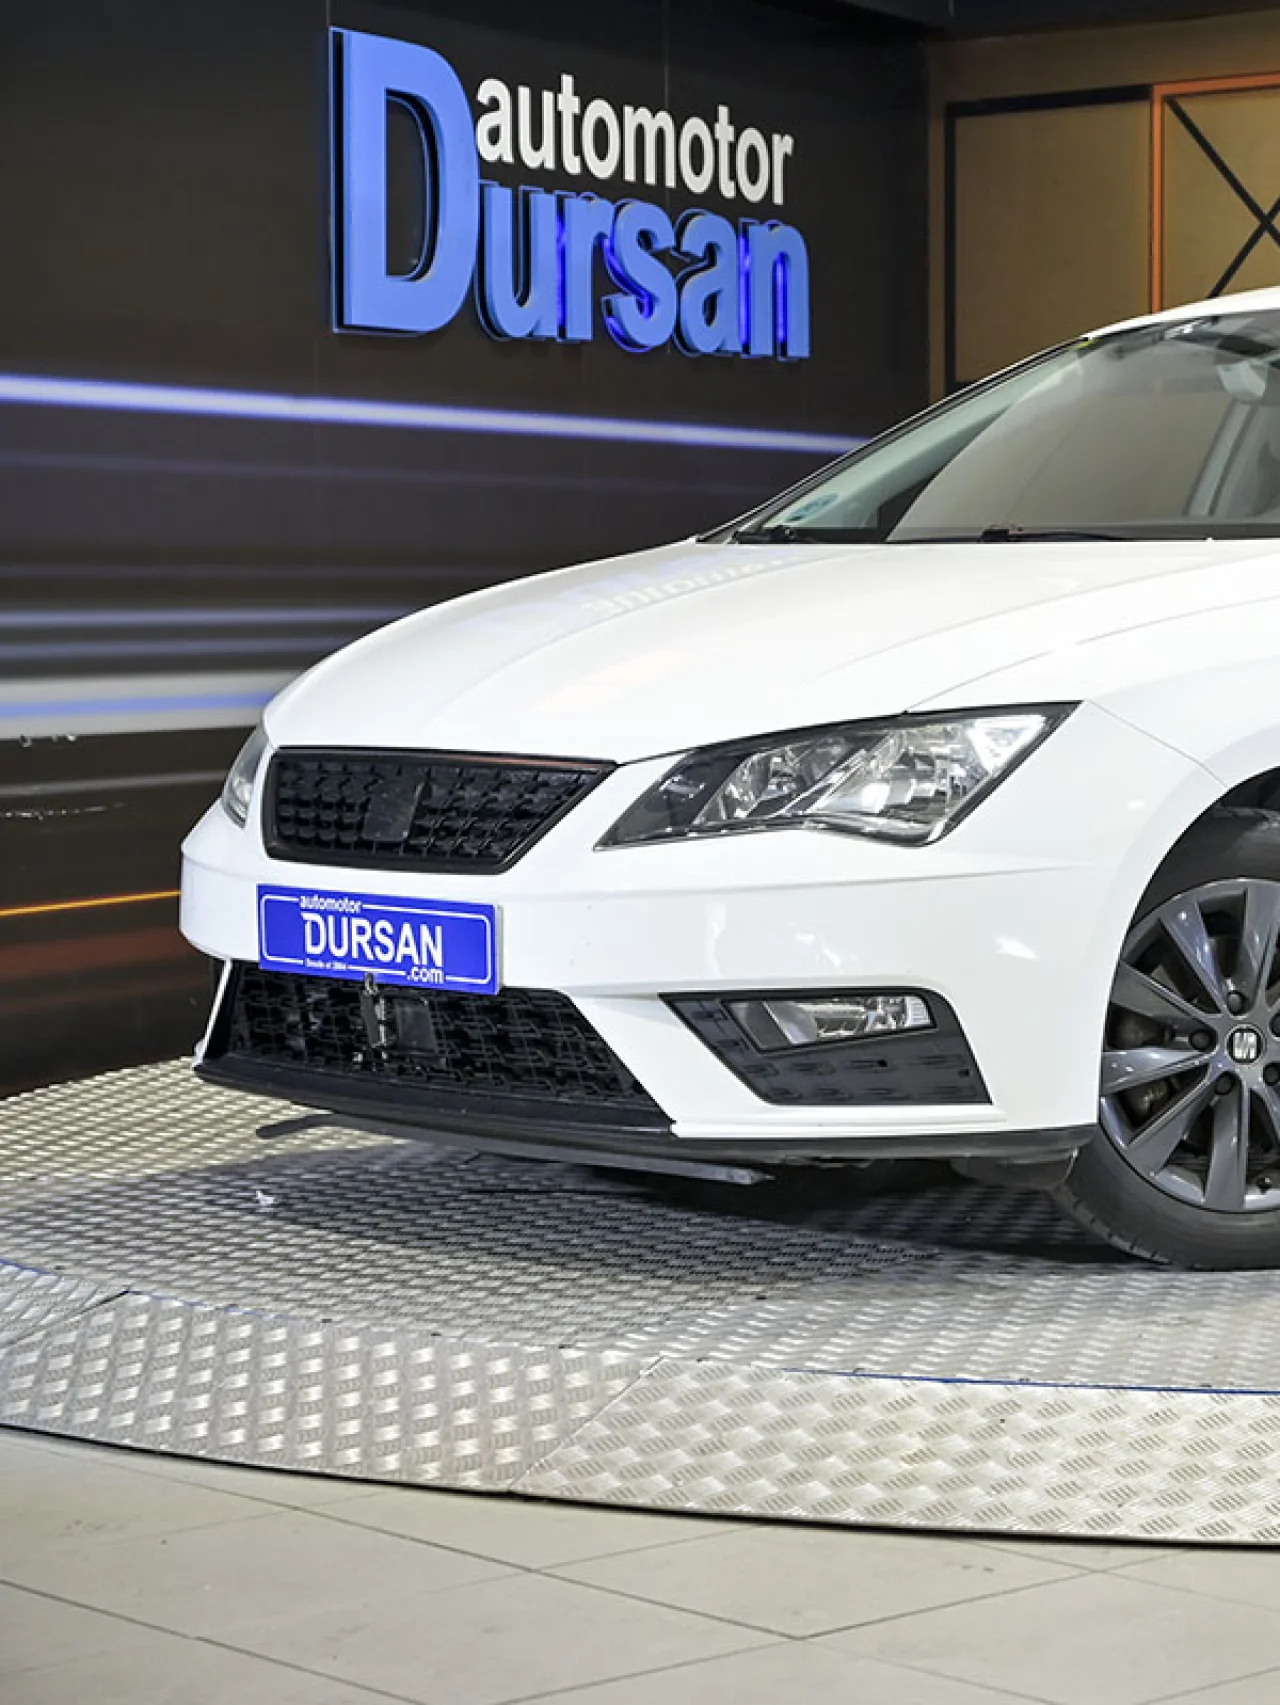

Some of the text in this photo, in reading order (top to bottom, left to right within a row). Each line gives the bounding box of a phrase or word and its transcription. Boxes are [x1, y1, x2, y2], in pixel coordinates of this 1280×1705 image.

[476, 74, 794, 205] automotor
[329, 26, 811, 360] Dursan
[300, 893, 361, 913] automotor
[301, 911, 443, 967] DURSAN
[406, 966, 444, 984] .com
